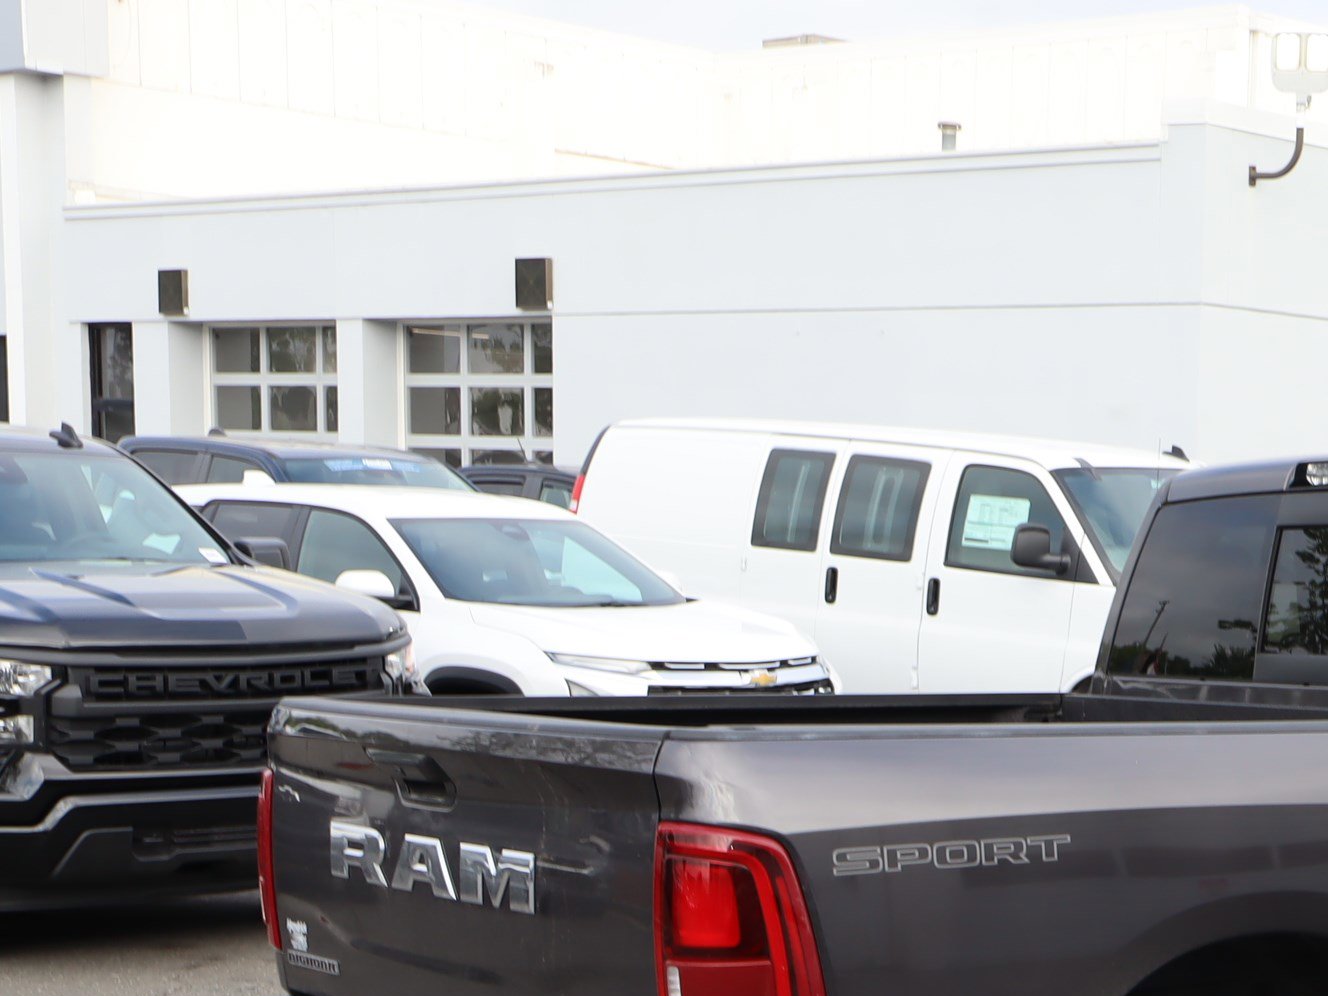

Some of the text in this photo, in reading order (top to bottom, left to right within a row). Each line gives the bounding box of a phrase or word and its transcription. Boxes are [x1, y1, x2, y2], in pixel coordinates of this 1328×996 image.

[89, 658, 379, 694] CHEVROLET
[330, 821, 536, 915] RAM
[832, 834, 1071, 876] SPORT
